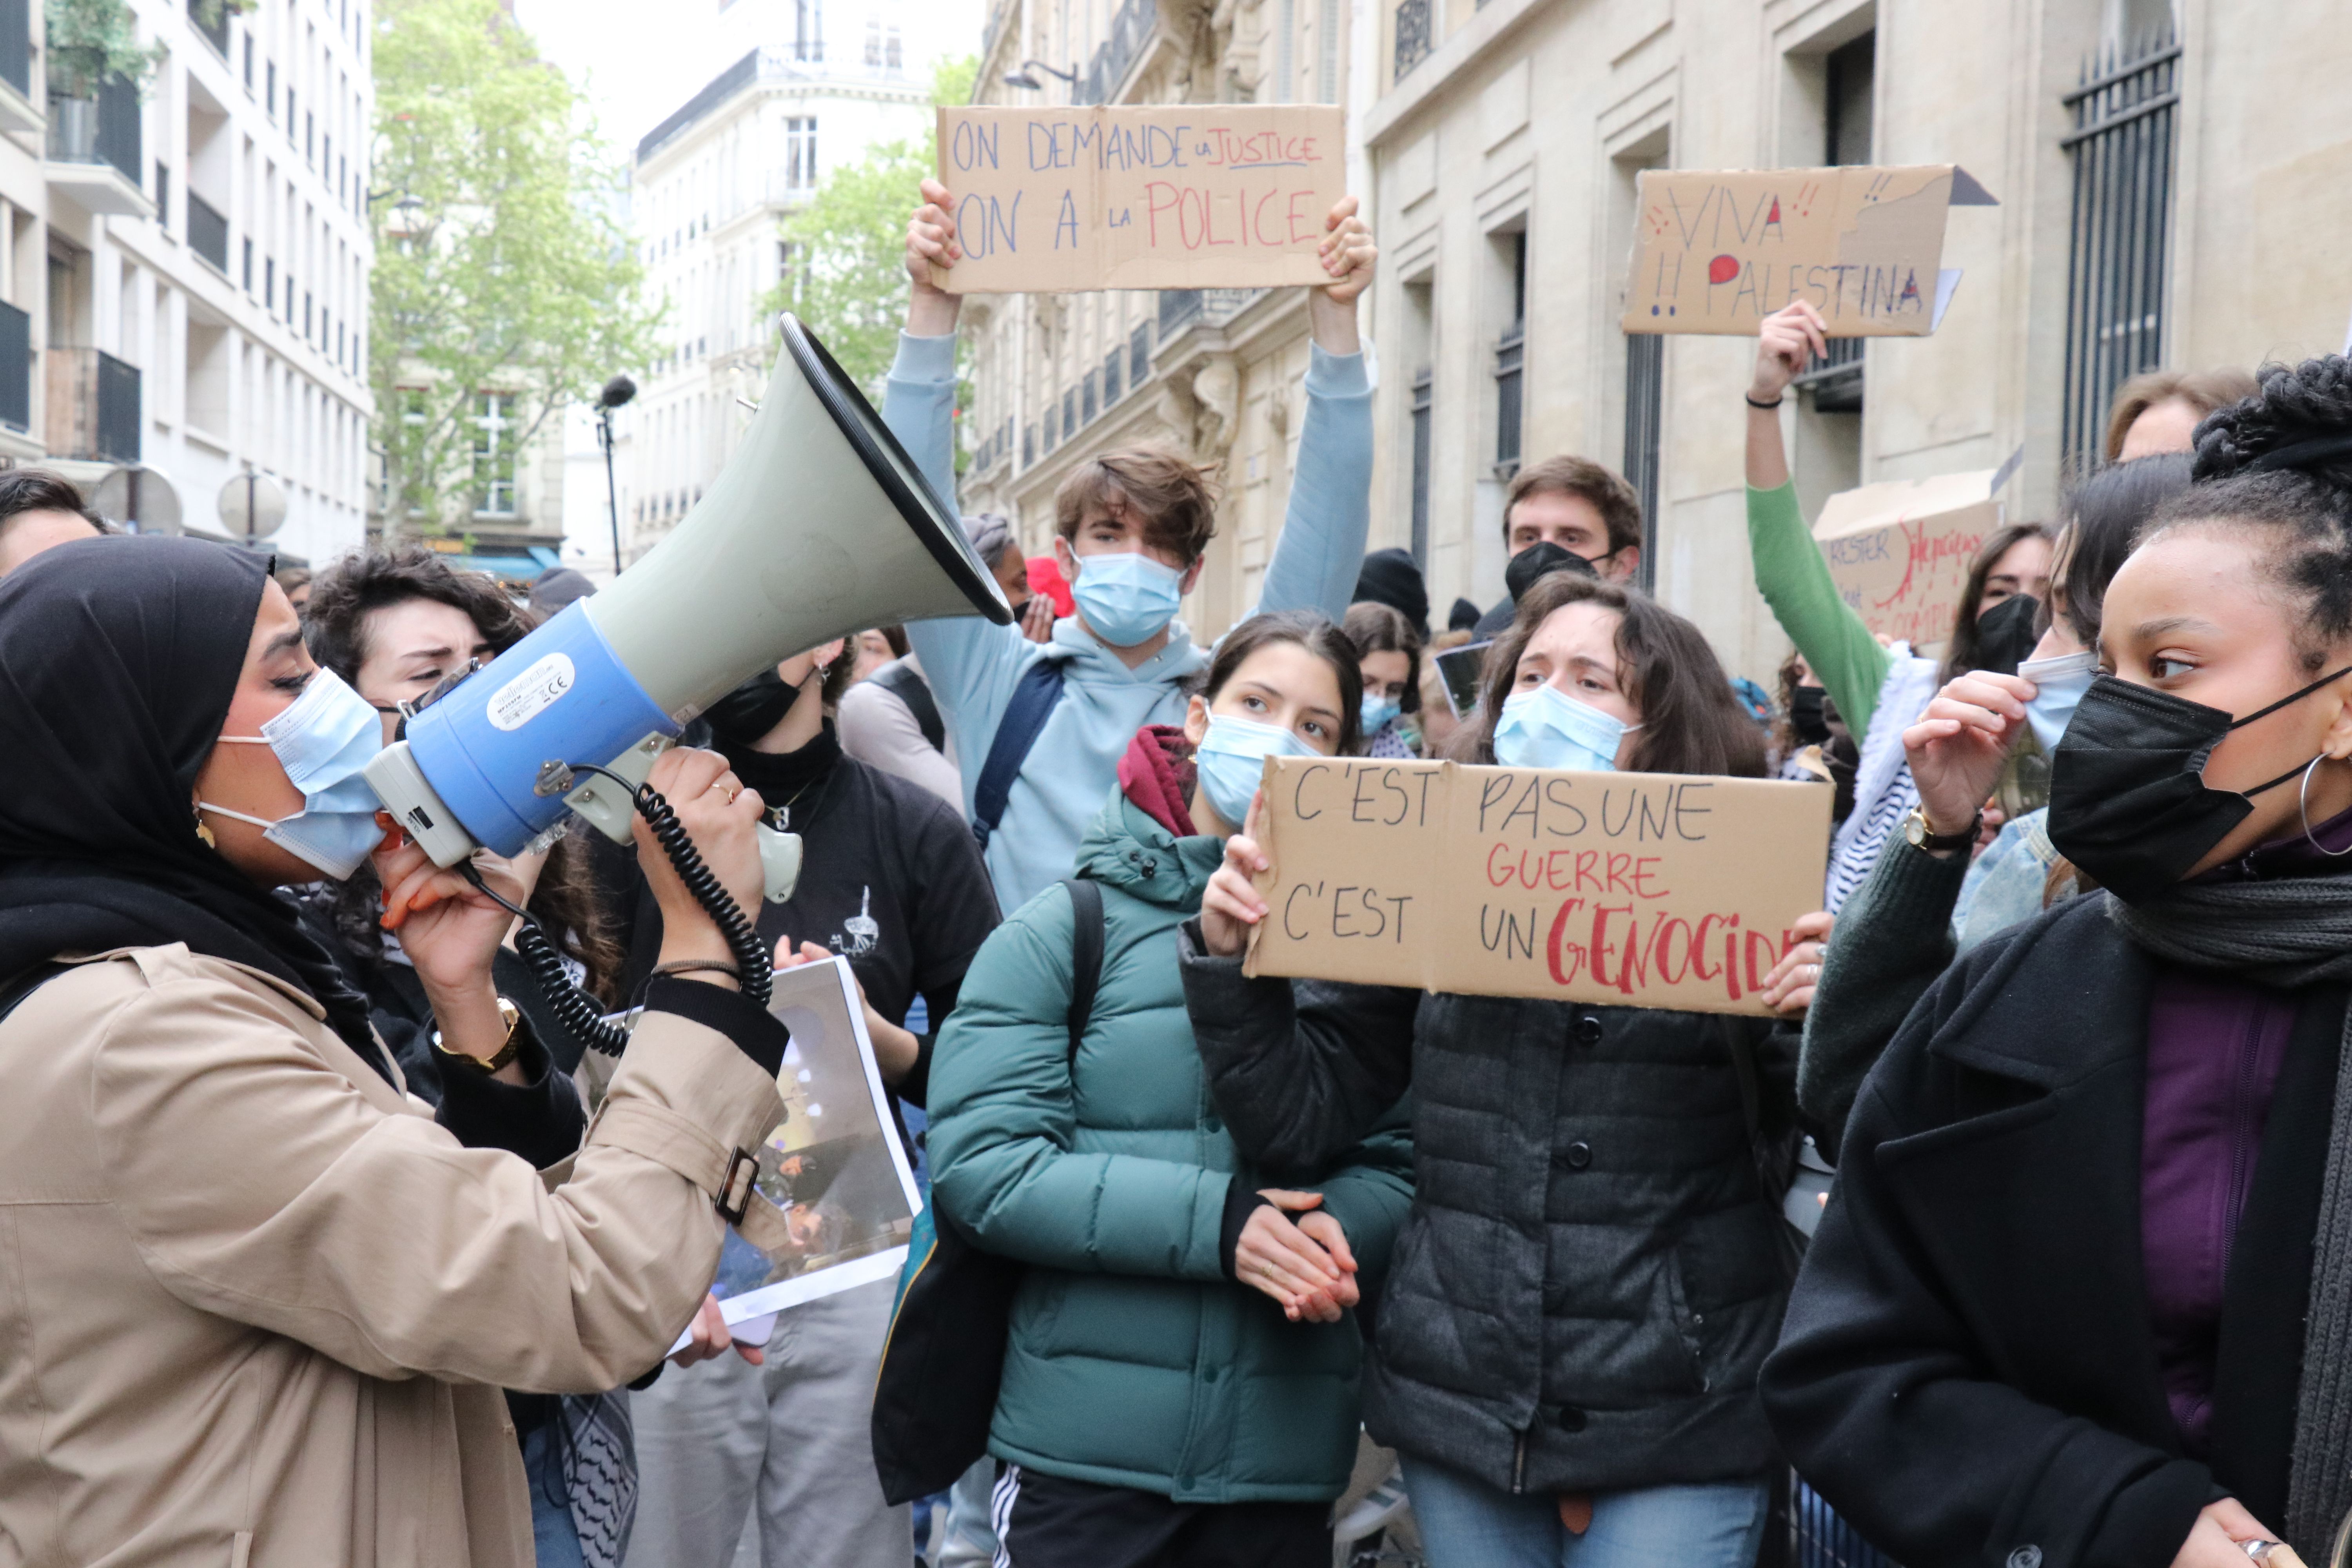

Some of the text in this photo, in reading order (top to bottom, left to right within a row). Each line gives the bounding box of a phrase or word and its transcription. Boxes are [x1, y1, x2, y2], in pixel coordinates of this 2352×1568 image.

[953, 120, 1323, 172] ON DEMANDE LA JUSTICE
[957, 182, 1317, 260] ON A LA POLICE
[1707, 254, 1922, 319] PALESTINA
[1295, 762, 1714, 842] C'EST PAS UNE
[1487, 843, 1670, 899] GUERRE
[1284, 881, 1793, 1002] C'EST UN GENOCiD
